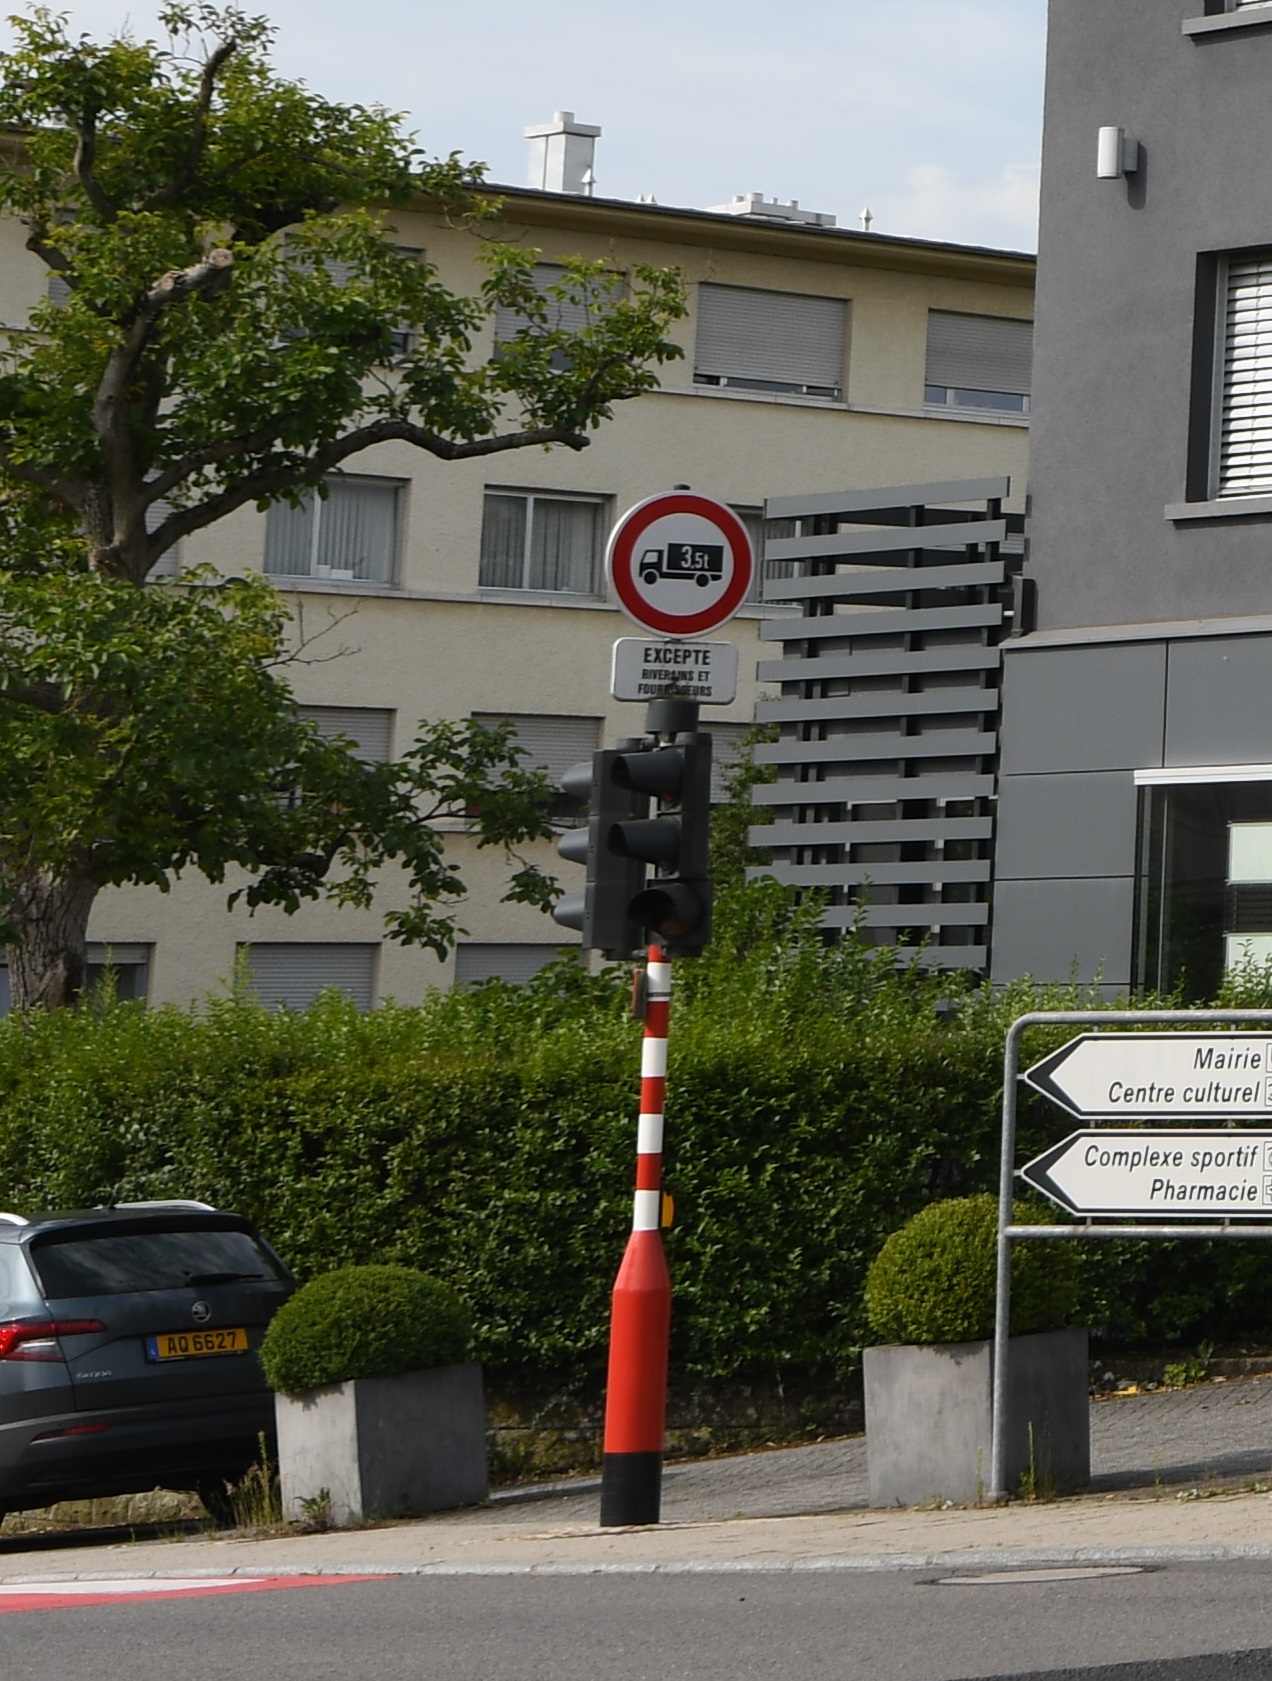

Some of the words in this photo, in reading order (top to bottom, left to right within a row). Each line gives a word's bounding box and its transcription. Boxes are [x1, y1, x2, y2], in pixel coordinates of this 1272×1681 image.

[643, 647, 711, 666] EXCEPTE
[698, 671, 711, 682] ET
[1193, 1047, 1262, 1070] Mairie
[1108, 1081, 1175, 1103] Centre
[1182, 1081, 1261, 1103] culturel
[1084, 1145, 1183, 1173] Complexe
[1190, 1145, 1259, 1173] sportif
[1150, 1179, 1258, 1201] Pharmacie
[168, 1336, 189, 1355] AQ
[193, 1331, 237, 1351] 6627
